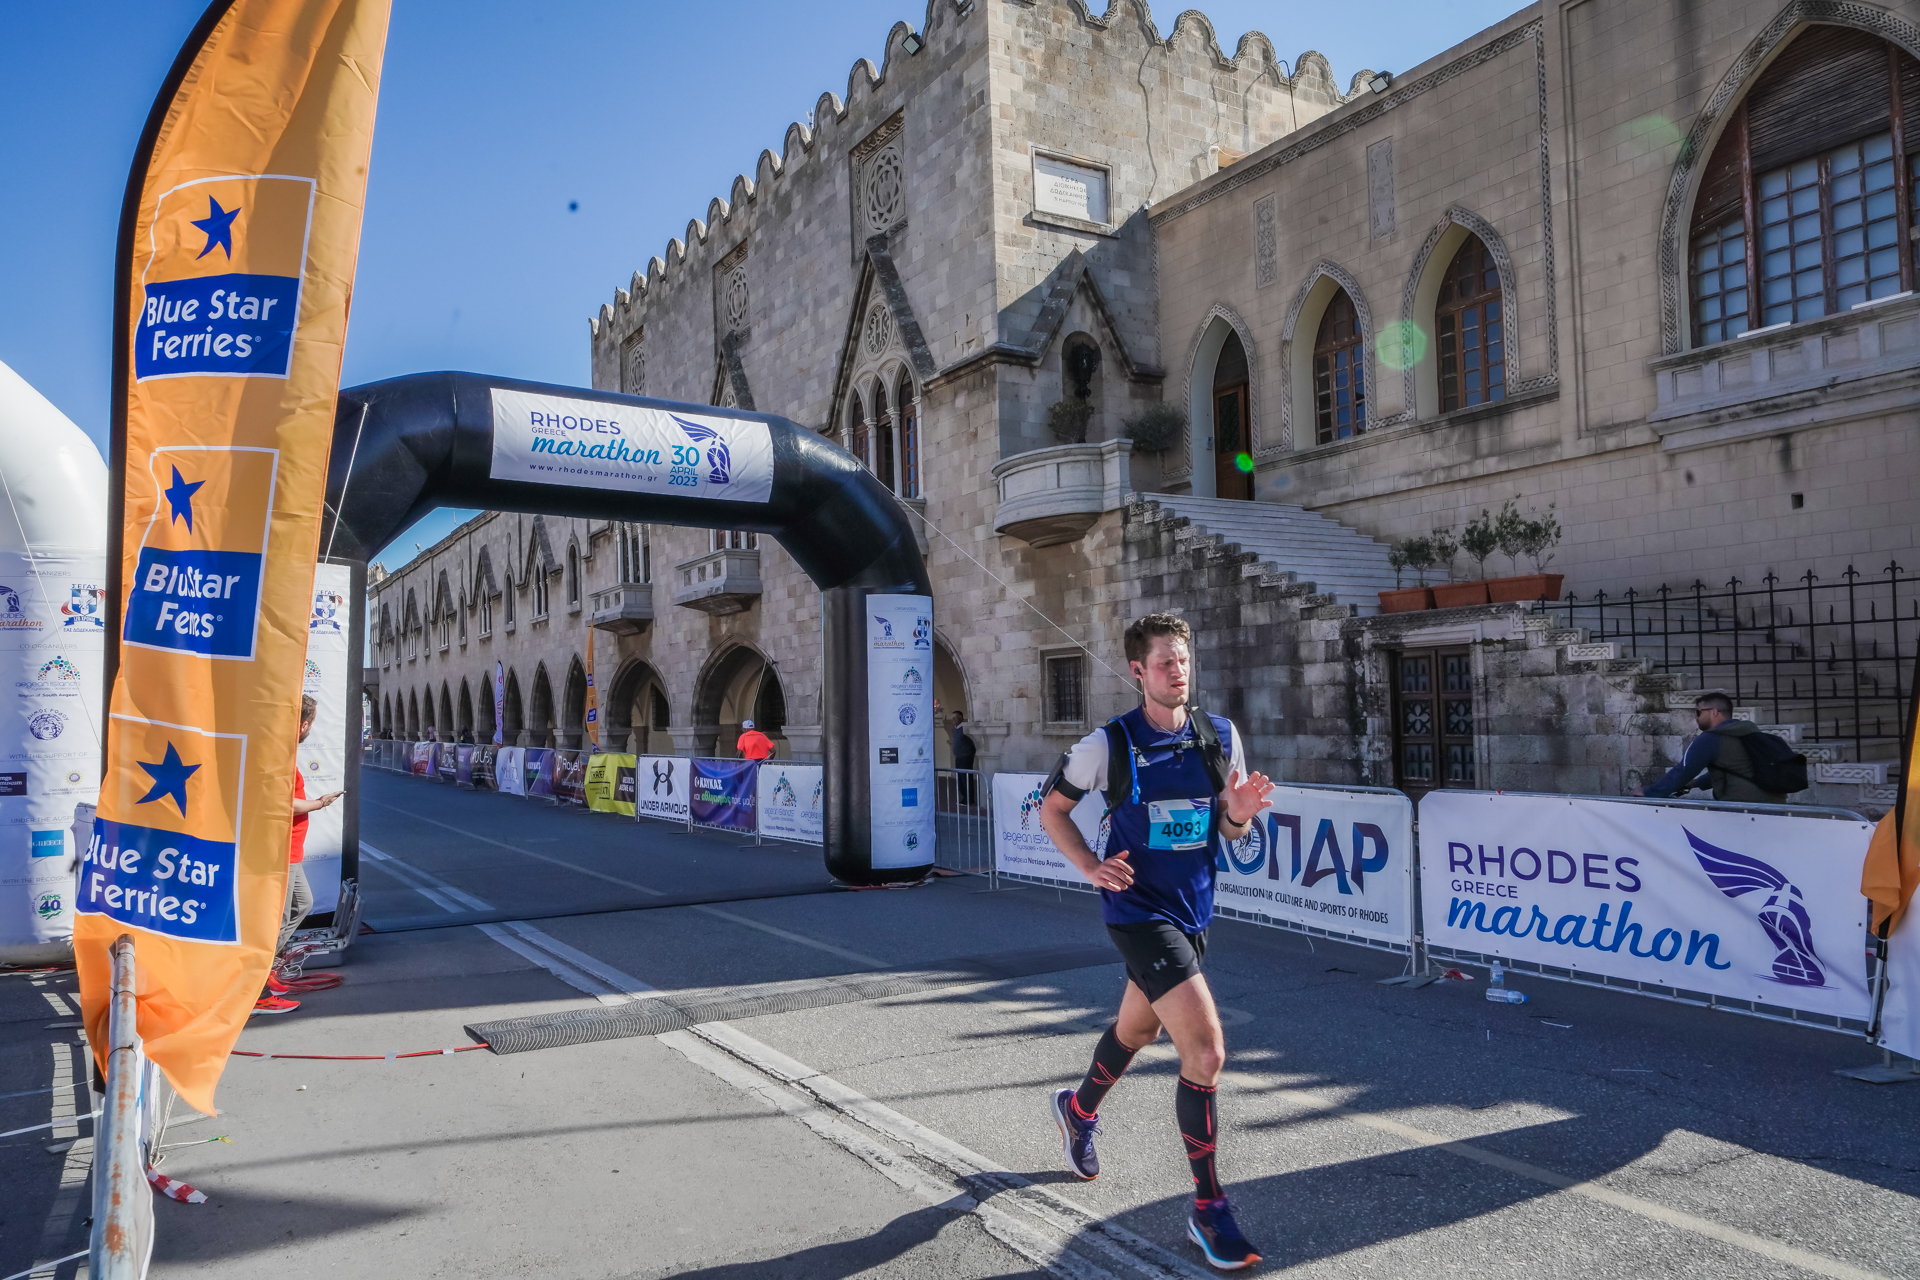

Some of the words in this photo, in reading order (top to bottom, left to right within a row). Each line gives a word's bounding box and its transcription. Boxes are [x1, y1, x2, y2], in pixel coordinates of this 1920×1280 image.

[147, 295, 199, 327] Blue
[208, 289, 278, 321] Star
[531, 411, 621, 436] RHODES
[531, 427, 567, 437] GREECE
[531, 436, 663, 466] marathon
[670, 444, 700, 467] 30
[529, 463, 658, 482] www.rhodesmarathon.gr
[669, 465, 699, 477] APRIL
[667, 475, 698, 488] 2023
[0, 618, 43, 627] arathon
[562, 757, 581, 773] Royal
[640, 799, 660, 812] UNDER
[660, 802, 689, 816] ARMOUR
[1161, 820, 1201, 838] 4093
[32, 839, 64, 847] GREECE
[1002, 831, 1033, 846] aegean
[153, 848, 220, 887] Star
[1448, 841, 1642, 893] RHODES
[1451, 879, 1518, 899] GREECE
[40, 900, 61, 911] 40
[1220, 884, 1265, 898] ORGANIZATION
[1275, 892, 1303, 908] CULTURE
[1304, 898, 1319, 911] AND
[1320, 902, 1347, 918] SPORTS
[1348, 907, 1358, 918] OF
[1359, 909, 1389, 924] RHODES
[1447, 897, 1731, 970] marathon
